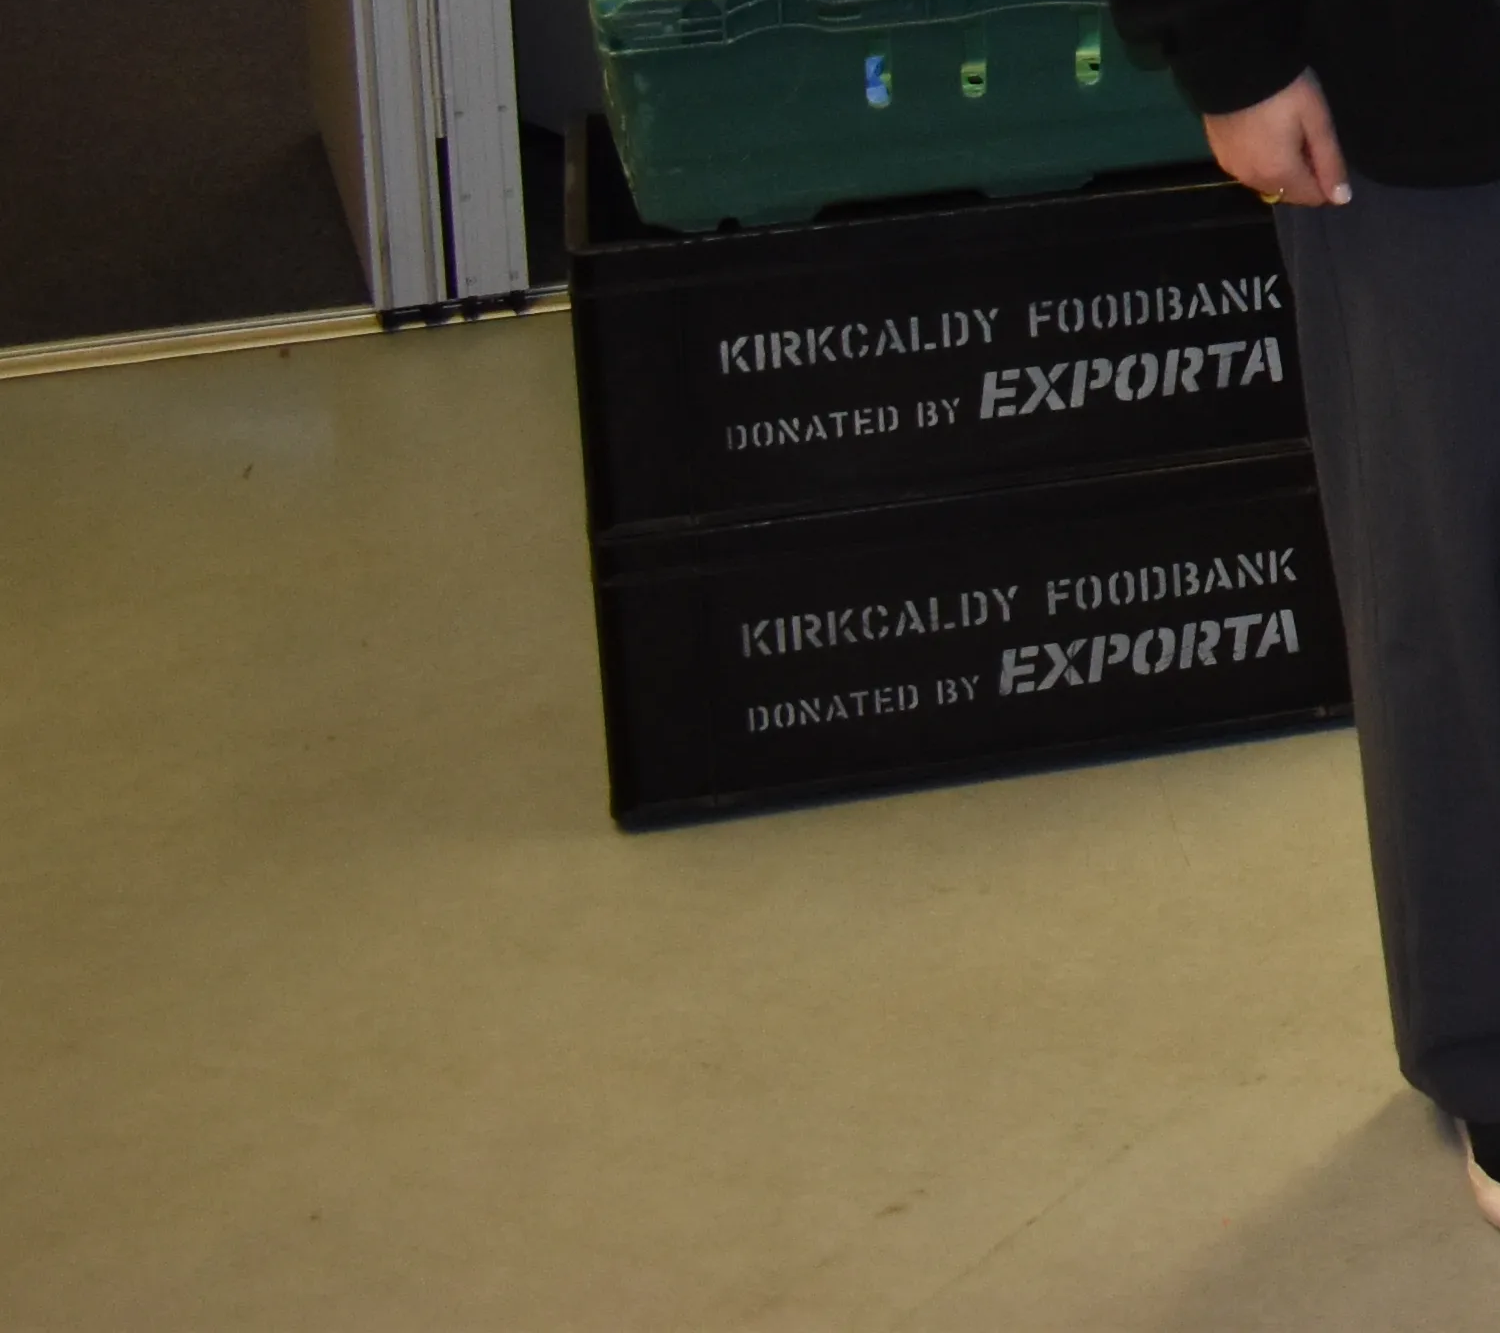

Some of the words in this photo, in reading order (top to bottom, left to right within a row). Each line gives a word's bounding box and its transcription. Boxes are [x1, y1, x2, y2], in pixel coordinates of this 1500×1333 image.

[719, 306, 999, 375] KIRKCALDY
[1028, 273, 1284, 339] FOODBANK
[725, 404, 901, 452] DONATED
[916, 397, 961, 429] BY
[978, 335, 1285, 421] EXPORTA
[741, 585, 1021, 660] KIRKCALDY
[1046, 546, 1300, 617] FOODBANK
[747, 681, 921, 733] DONATED
[935, 674, 980, 707] BY
[998, 607, 1302, 697] EXPORTA
